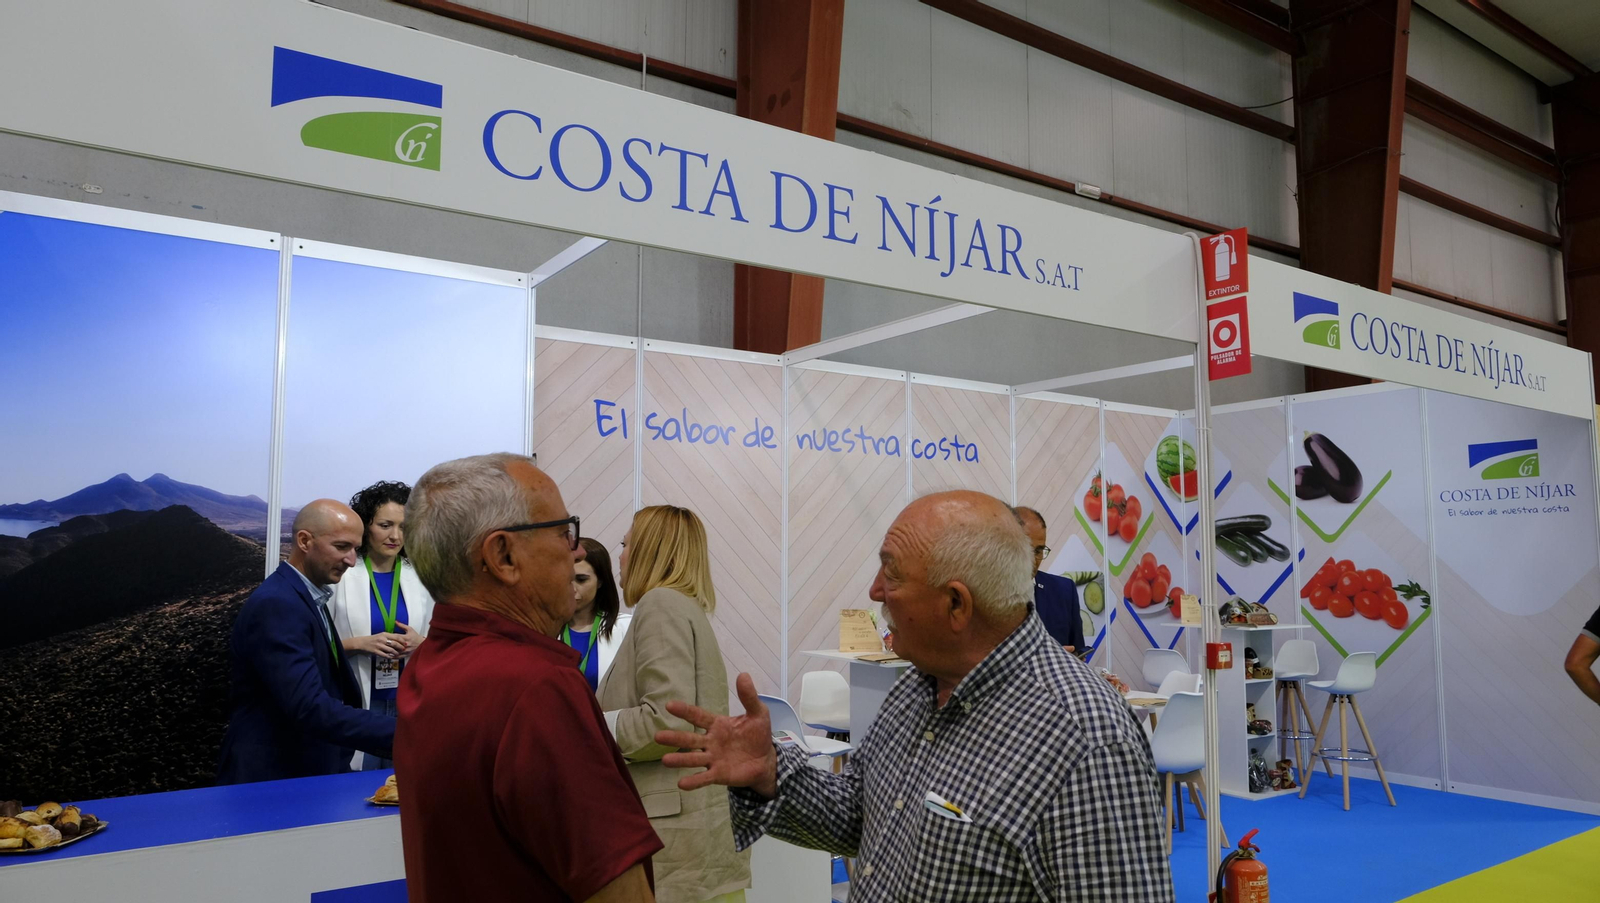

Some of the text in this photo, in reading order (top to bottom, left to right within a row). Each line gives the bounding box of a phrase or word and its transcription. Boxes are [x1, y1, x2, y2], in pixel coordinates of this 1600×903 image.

[482, 109, 1084, 291] COSTA DE NÍJAR S.A.T
[1209, 285, 1240, 297] EXTINTOR
[1211, 352, 1234, 361] PULSADOR
[1350, 312, 1432, 366] COSTA
[1435, 334, 1467, 373] DE
[1471, 342, 1527, 389] NÍJAR
[1217, 356, 1236, 365] ALARMA
[594, 399, 979, 464] El sabor de nuestra costa
[1440, 482, 1577, 503] COSTA DE NÍJAR
[1448, 505, 1570, 517] El sabor de nuestra costa
